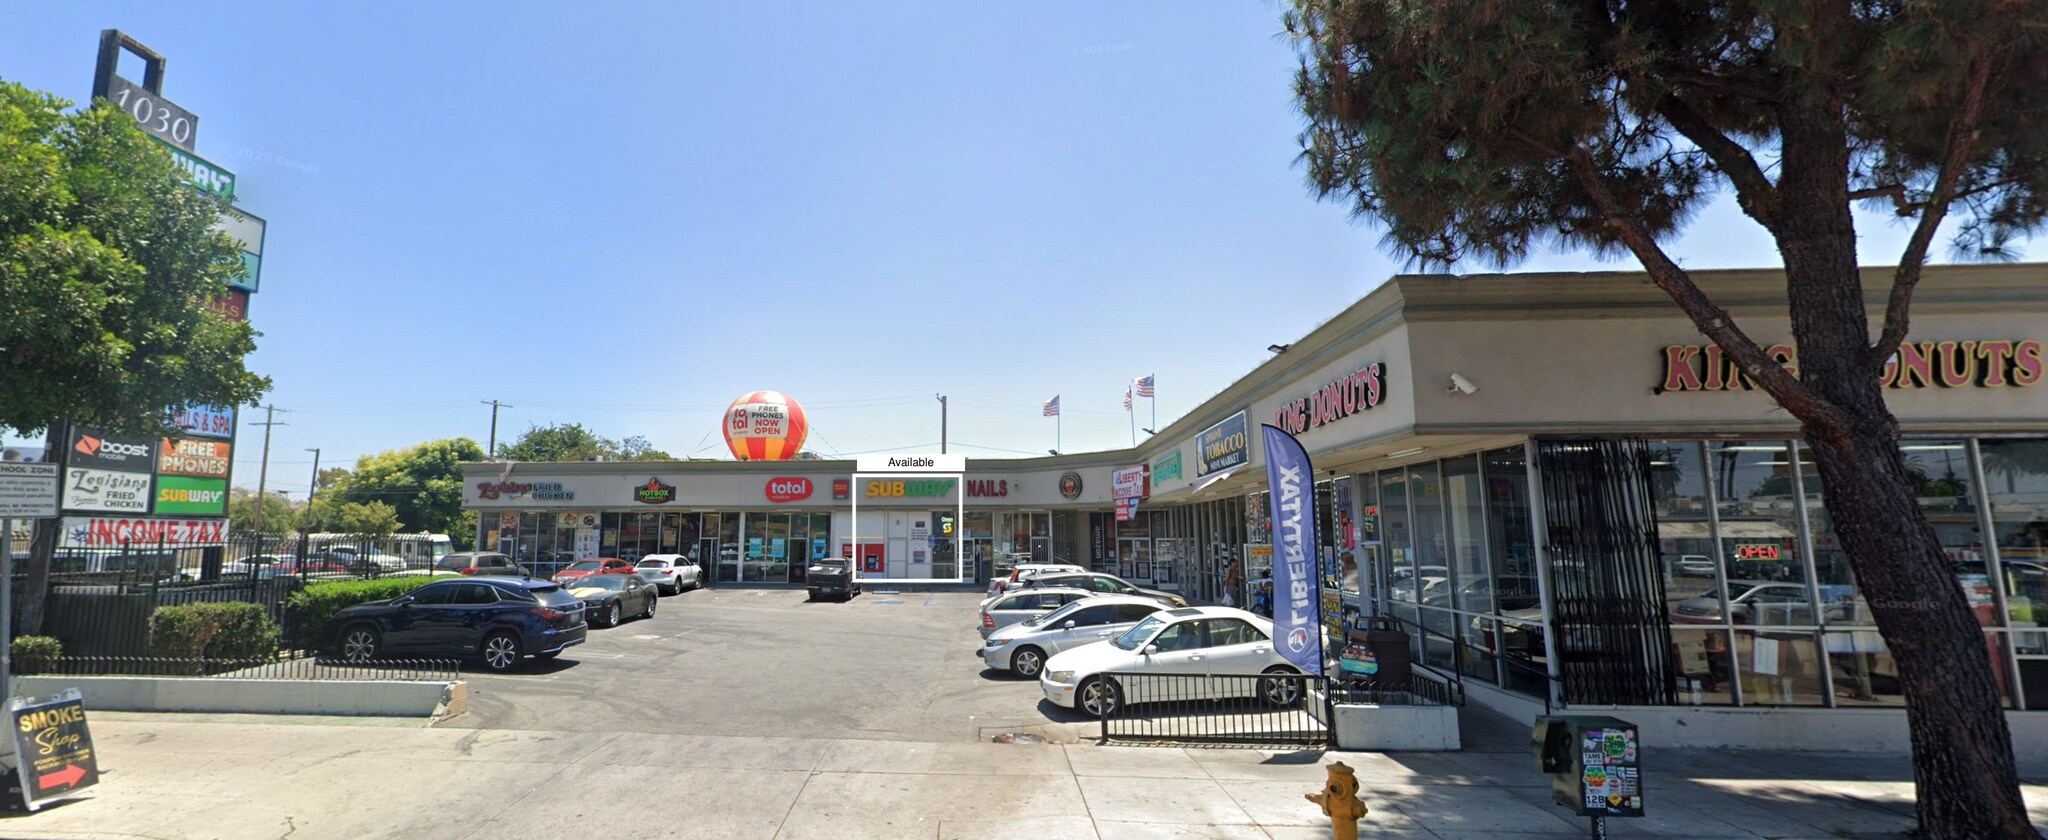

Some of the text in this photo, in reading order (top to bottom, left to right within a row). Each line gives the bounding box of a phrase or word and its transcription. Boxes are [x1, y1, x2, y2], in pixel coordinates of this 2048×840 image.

[117, 88, 191, 143] 1030
[1273, 363, 1380, 434] KING DONUTS
[212, 415, 230, 435] SPA
[754, 427, 781, 435] OPEN
[755, 419, 779, 427] NOW
[100, 439, 149, 458] boost
[179, 439, 216, 457] FREE
[1205, 431, 1244, 460] TOBACCO
[98, 453, 126, 462] mobile
[161, 456, 227, 475] PHONES
[71, 470, 148, 495] Louisiana
[533, 483, 563, 492] FRIED
[771, 479, 806, 494] total
[864, 479, 955, 498] SUBWAY
[967, 479, 1007, 497] NAILS
[106, 490, 135, 500] FRIED
[159, 488, 223, 503] SUBWAY
[532, 491, 574, 500] CHICKEN
[639, 489, 669, 497] HOTBOX
[103, 500, 145, 508] CHICKEN
[87, 518, 225, 545] INCOME TAX
[1738, 546, 1780, 559] OPEN
[19, 705, 84, 732] SMOKE
[34, 727, 81, 755] Shop
